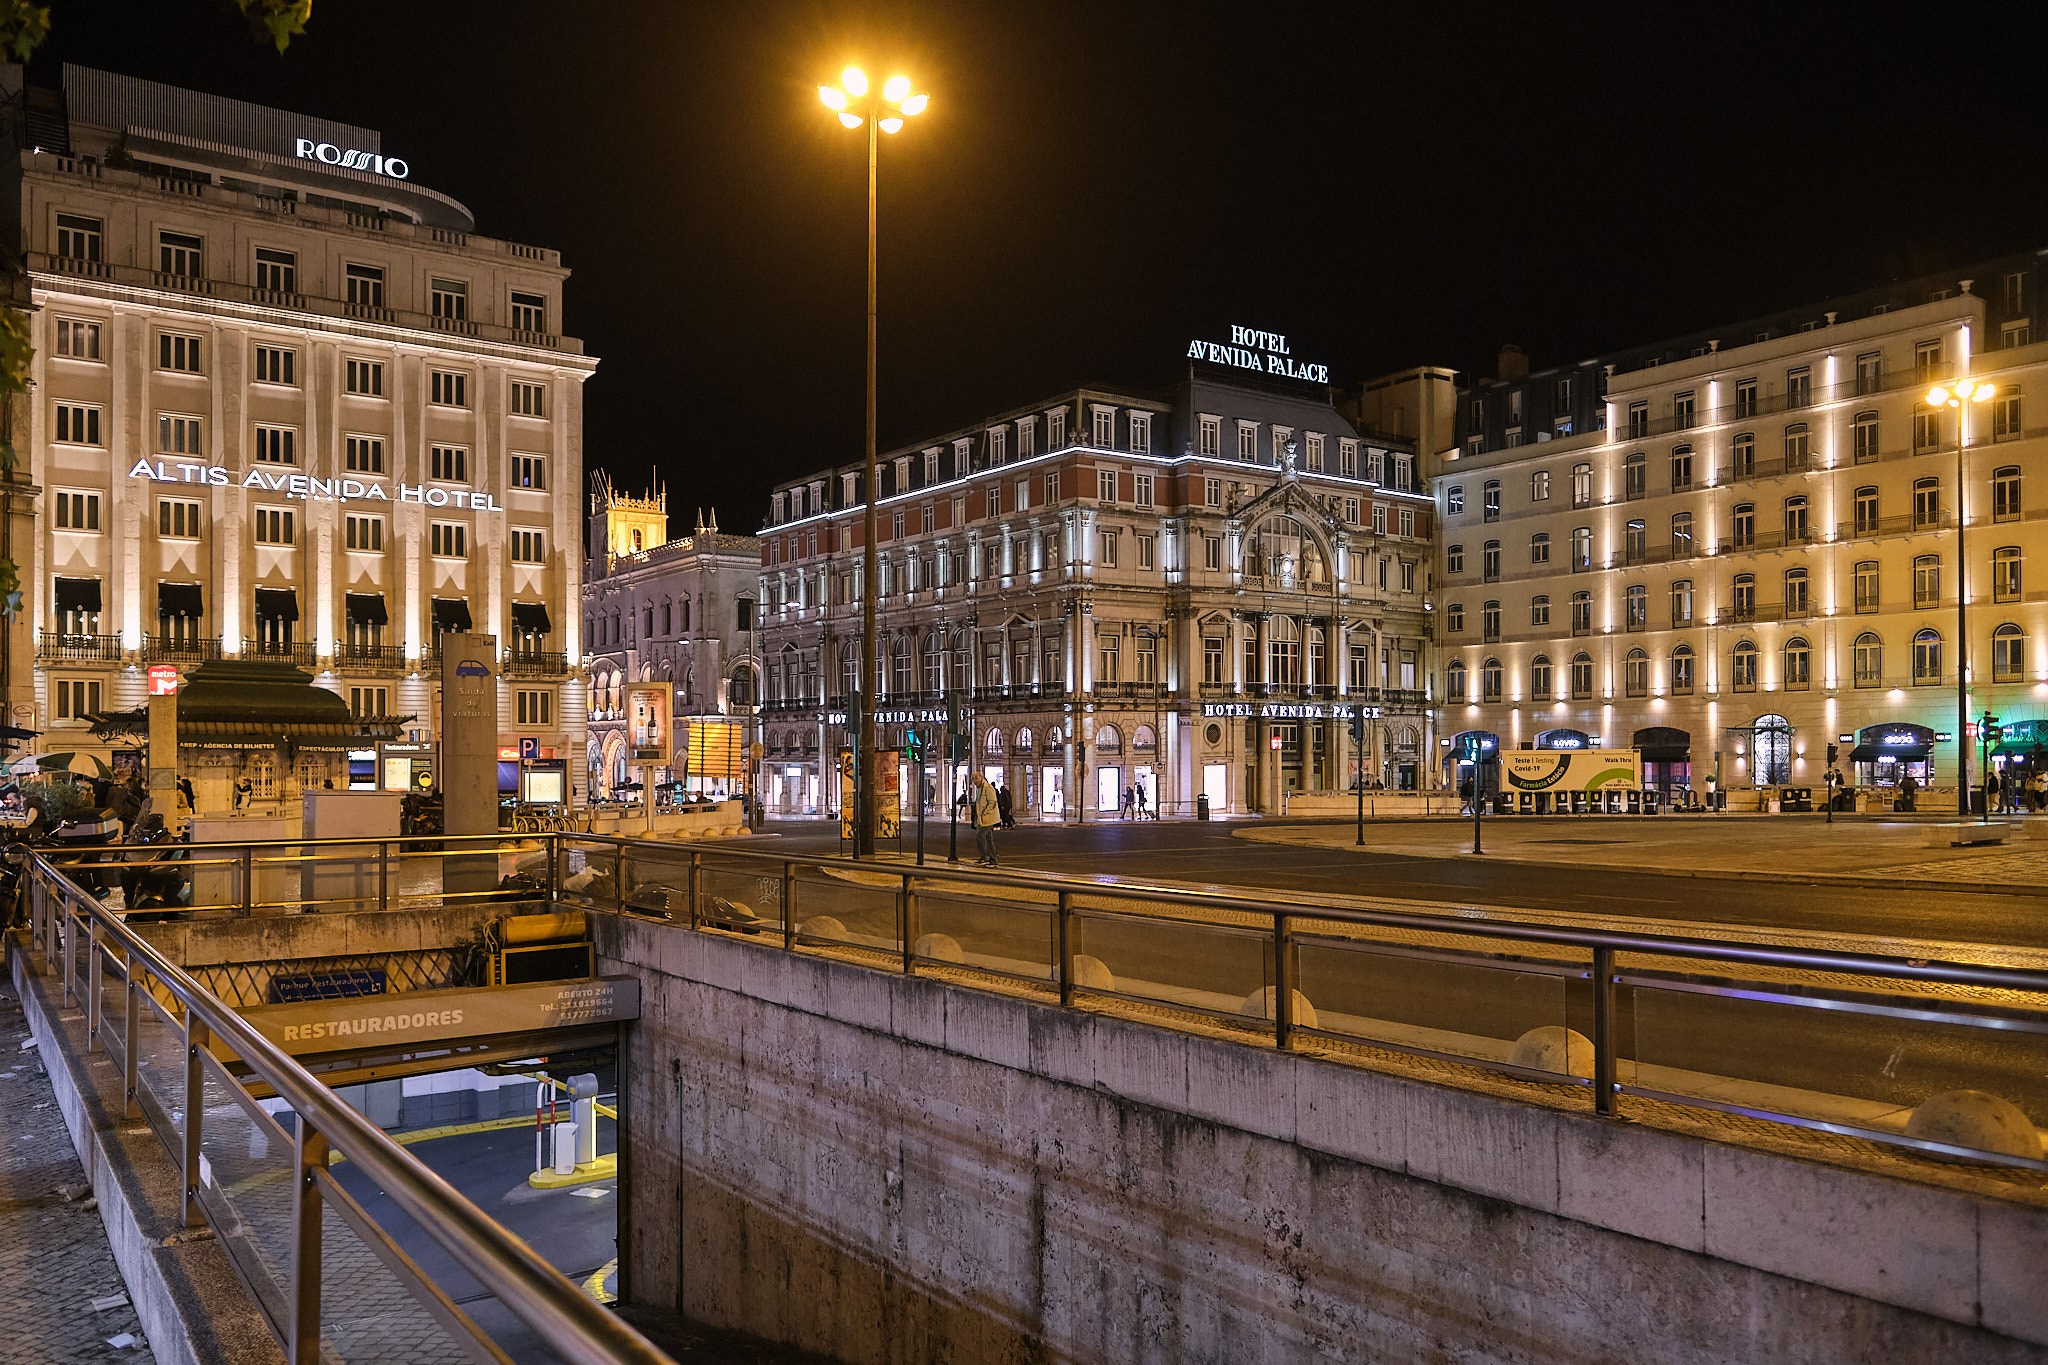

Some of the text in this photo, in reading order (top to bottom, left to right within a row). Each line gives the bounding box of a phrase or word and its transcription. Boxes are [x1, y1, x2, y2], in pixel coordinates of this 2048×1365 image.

[296, 137, 409, 179] ROSSIO
[1231, 325, 1290, 355] HOTEL
[1187, 339, 1329, 384] AVENIDA PALACE
[128, 458, 504, 512] ALTIS AVENIDA HOTEL
[151, 670, 177, 678] metro
[466, 699, 478, 707] de
[828, 712, 847, 724] HOT
[873, 710, 915, 723] VENIDA
[1204, 704, 1380, 719] HOTEL AVENIDA PALCE
[522, 739, 534, 757] P
[1535, 757, 1555, 765] Testing
[558, 987, 614, 1000] ABERTO 24H
[284, 1009, 463, 1041] RESTAURADORES
